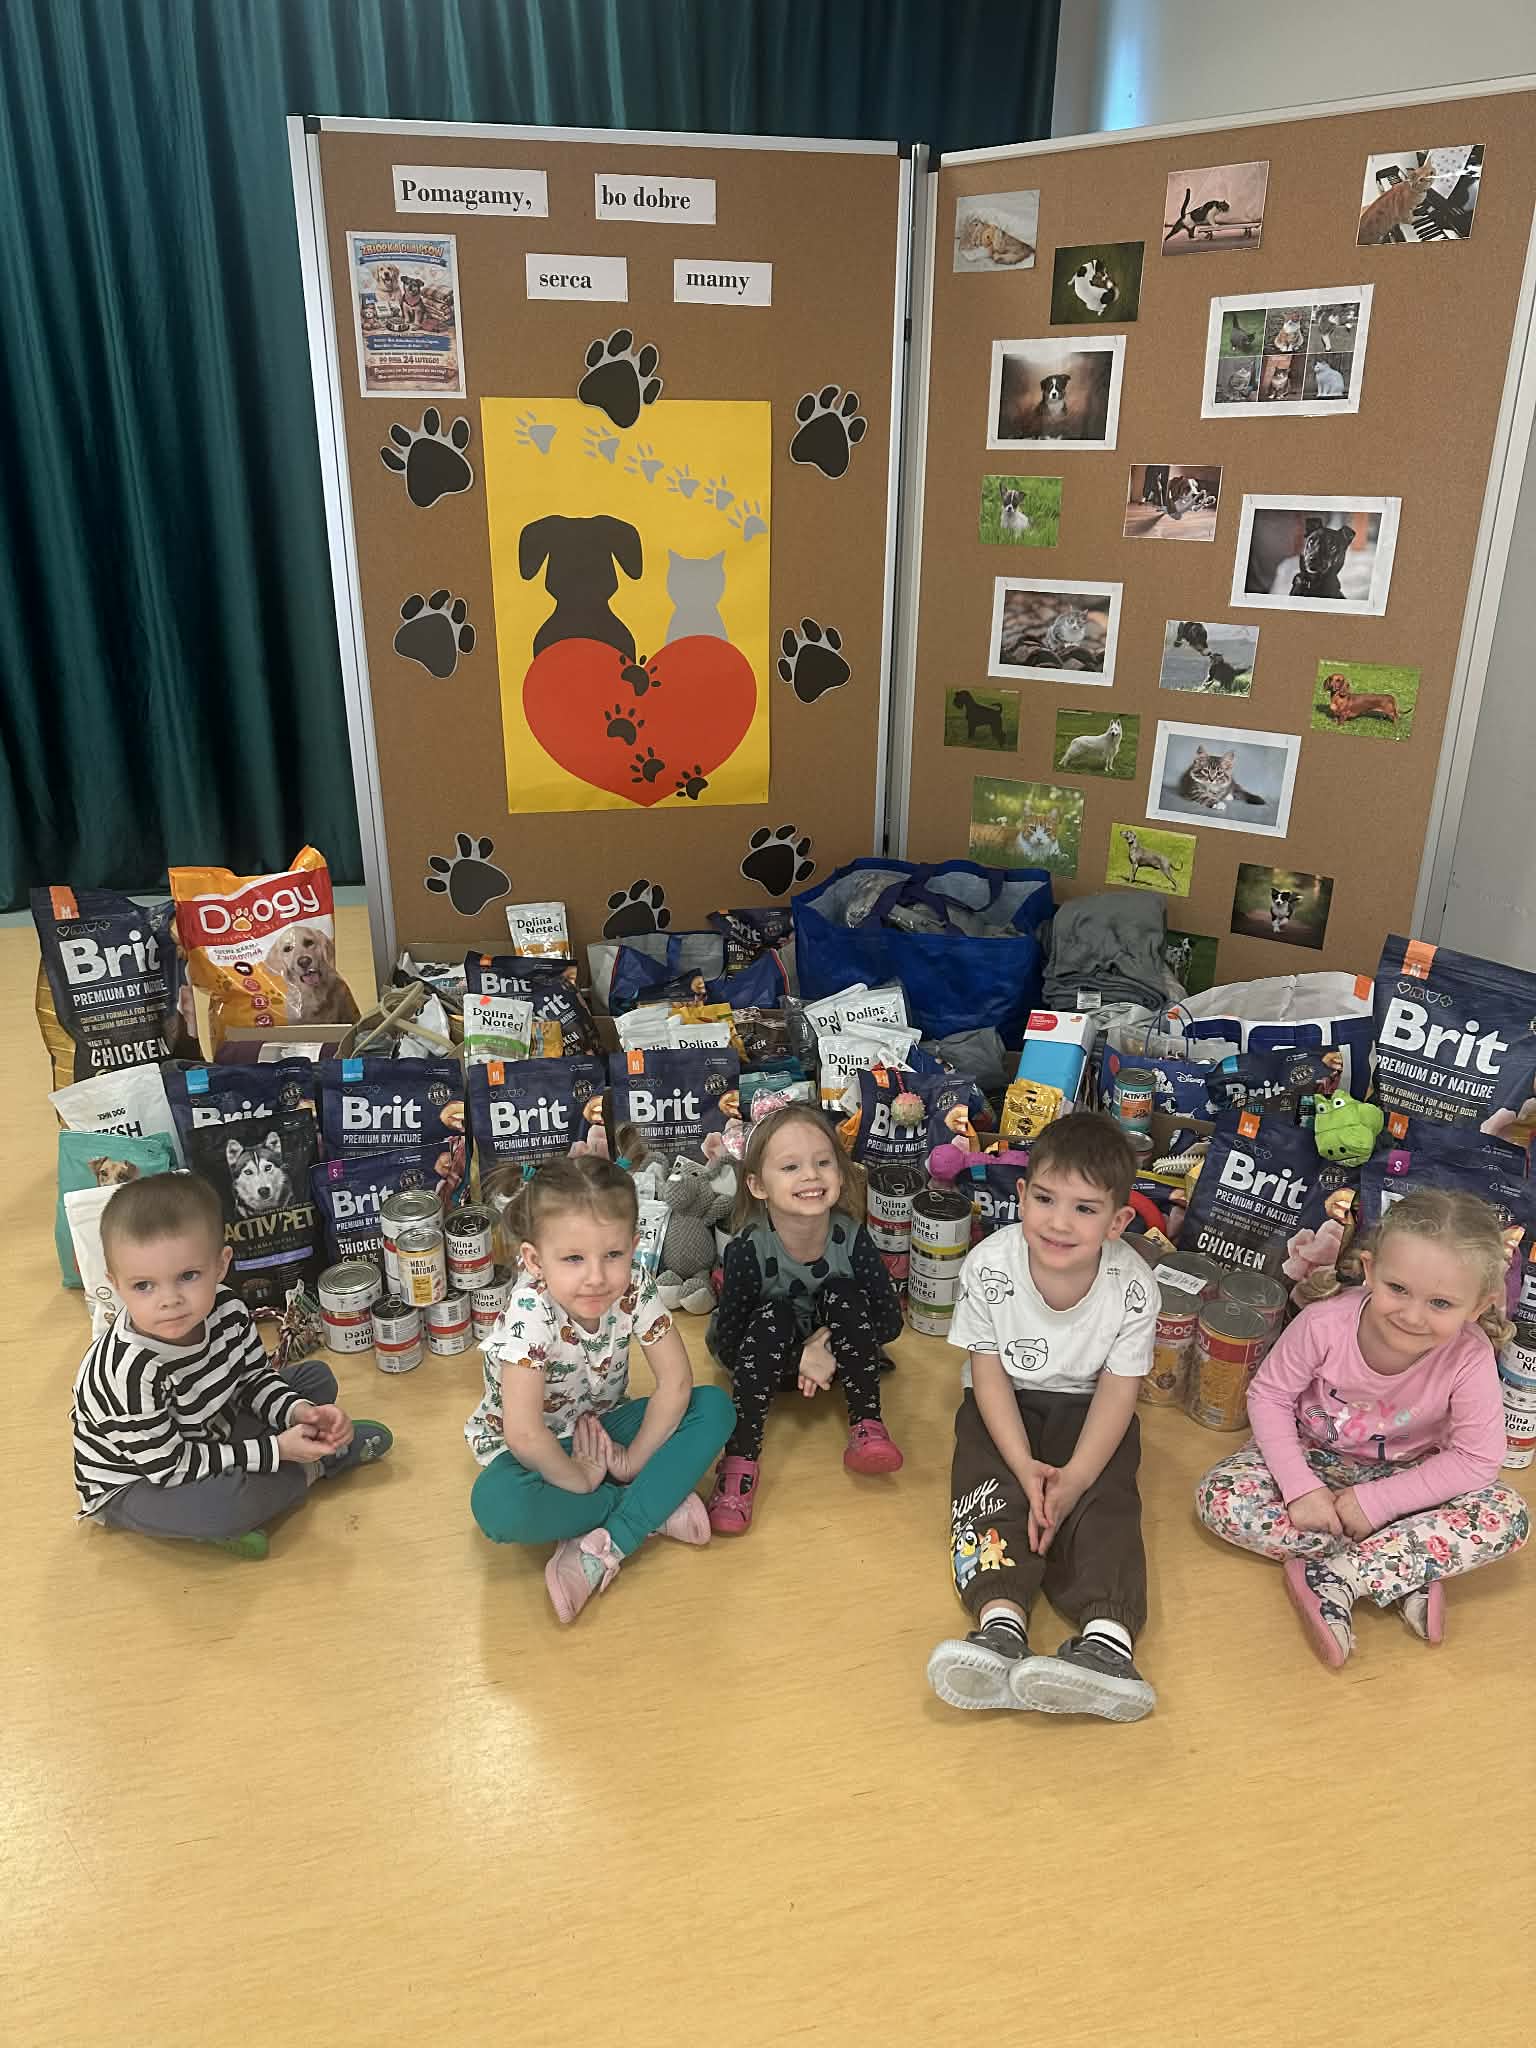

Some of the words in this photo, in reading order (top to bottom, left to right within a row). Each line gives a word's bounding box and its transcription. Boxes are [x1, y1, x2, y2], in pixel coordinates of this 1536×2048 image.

[400, 178, 533, 211] Pomagamy,
[601, 185, 627, 207] bo
[633, 187, 691, 210] dobre
[538, 269, 593, 290] serca
[686, 271, 751, 295] mamy
[517, 916, 552, 930] Dolina
[58, 930, 161, 985] Brit
[1410, 963, 1421, 978] M
[480, 971, 534, 995] Brit
[73, 986, 125, 1007] PREMIUM
[126, 983, 141, 997] BY
[473, 1006, 514, 1021] Dolina
[536, 993, 571, 1020] rit
[481, 1016, 524, 1033] Noteci
[817, 1010, 840, 1028] Dol
[678, 1039, 719, 1050] Dolina
[1378, 996, 1510, 1075] Brit
[90, 1036, 171, 1067] CHICKEN
[828, 1053, 871, 1066] Dolina
[632, 1061, 640, 1071] M
[492, 1071, 500, 1081] M
[1176, 1070, 1206, 1087] Disney
[1376, 1053, 1428, 1083] PREMIUM
[1428, 1070, 1448, 1088] BY
[1447, 1075, 1495, 1100] NATURE
[628, 1088, 701, 1123] Brit
[1380, 1092, 1403, 1106] EDIUM
[1395, 1086, 1424, 1103] FORMULA
[1424, 1096, 1438, 1107] FOR
[1438, 1101, 1460, 1114] ADULT
[1459, 1107, 1478, 1118] DOGS
[112, 1107, 126, 1117] DOG
[191, 1100, 274, 1129] Brit
[342, 1094, 422, 1130] Brit
[489, 1096, 569, 1137] Brit
[640, 1126, 664, 1137] EMIUM
[665, 1126, 674, 1137] BY
[674, 1124, 703, 1136] NATURE
[1392, 1122, 1402, 1135] M
[343, 1133, 380, 1144] PREMIUM
[381, 1133, 391, 1144] BY
[392, 1133, 422, 1143] NATURE
[494, 1138, 530, 1151] PREMIUM
[530, 1136, 541, 1146] BY
[542, 1133, 569, 1146] NATURE
[894, 1144, 904, 1153] BY
[332, 1168, 338, 1178] S
[1393, 1160, 1403, 1172] S
[1219, 1149, 1308, 1210] Brit
[874, 1195, 907, 1210] Dolina
[881, 1205, 913, 1218] Notec
[974, 1190, 1020, 1220] Bri
[1215, 1188, 1253, 1211] PREMIUM
[1253, 1202, 1267, 1215] BY
[1265, 1206, 1300, 1226] NATURE
[339, 1237, 384, 1256] CHICKEN
[1197, 1232, 1266, 1271] CHICKEN
[409, 1259, 427, 1268] MAXI
[411, 1264, 438, 1276] NATURAL
[1516, 1350, 1536, 1364] Dol
